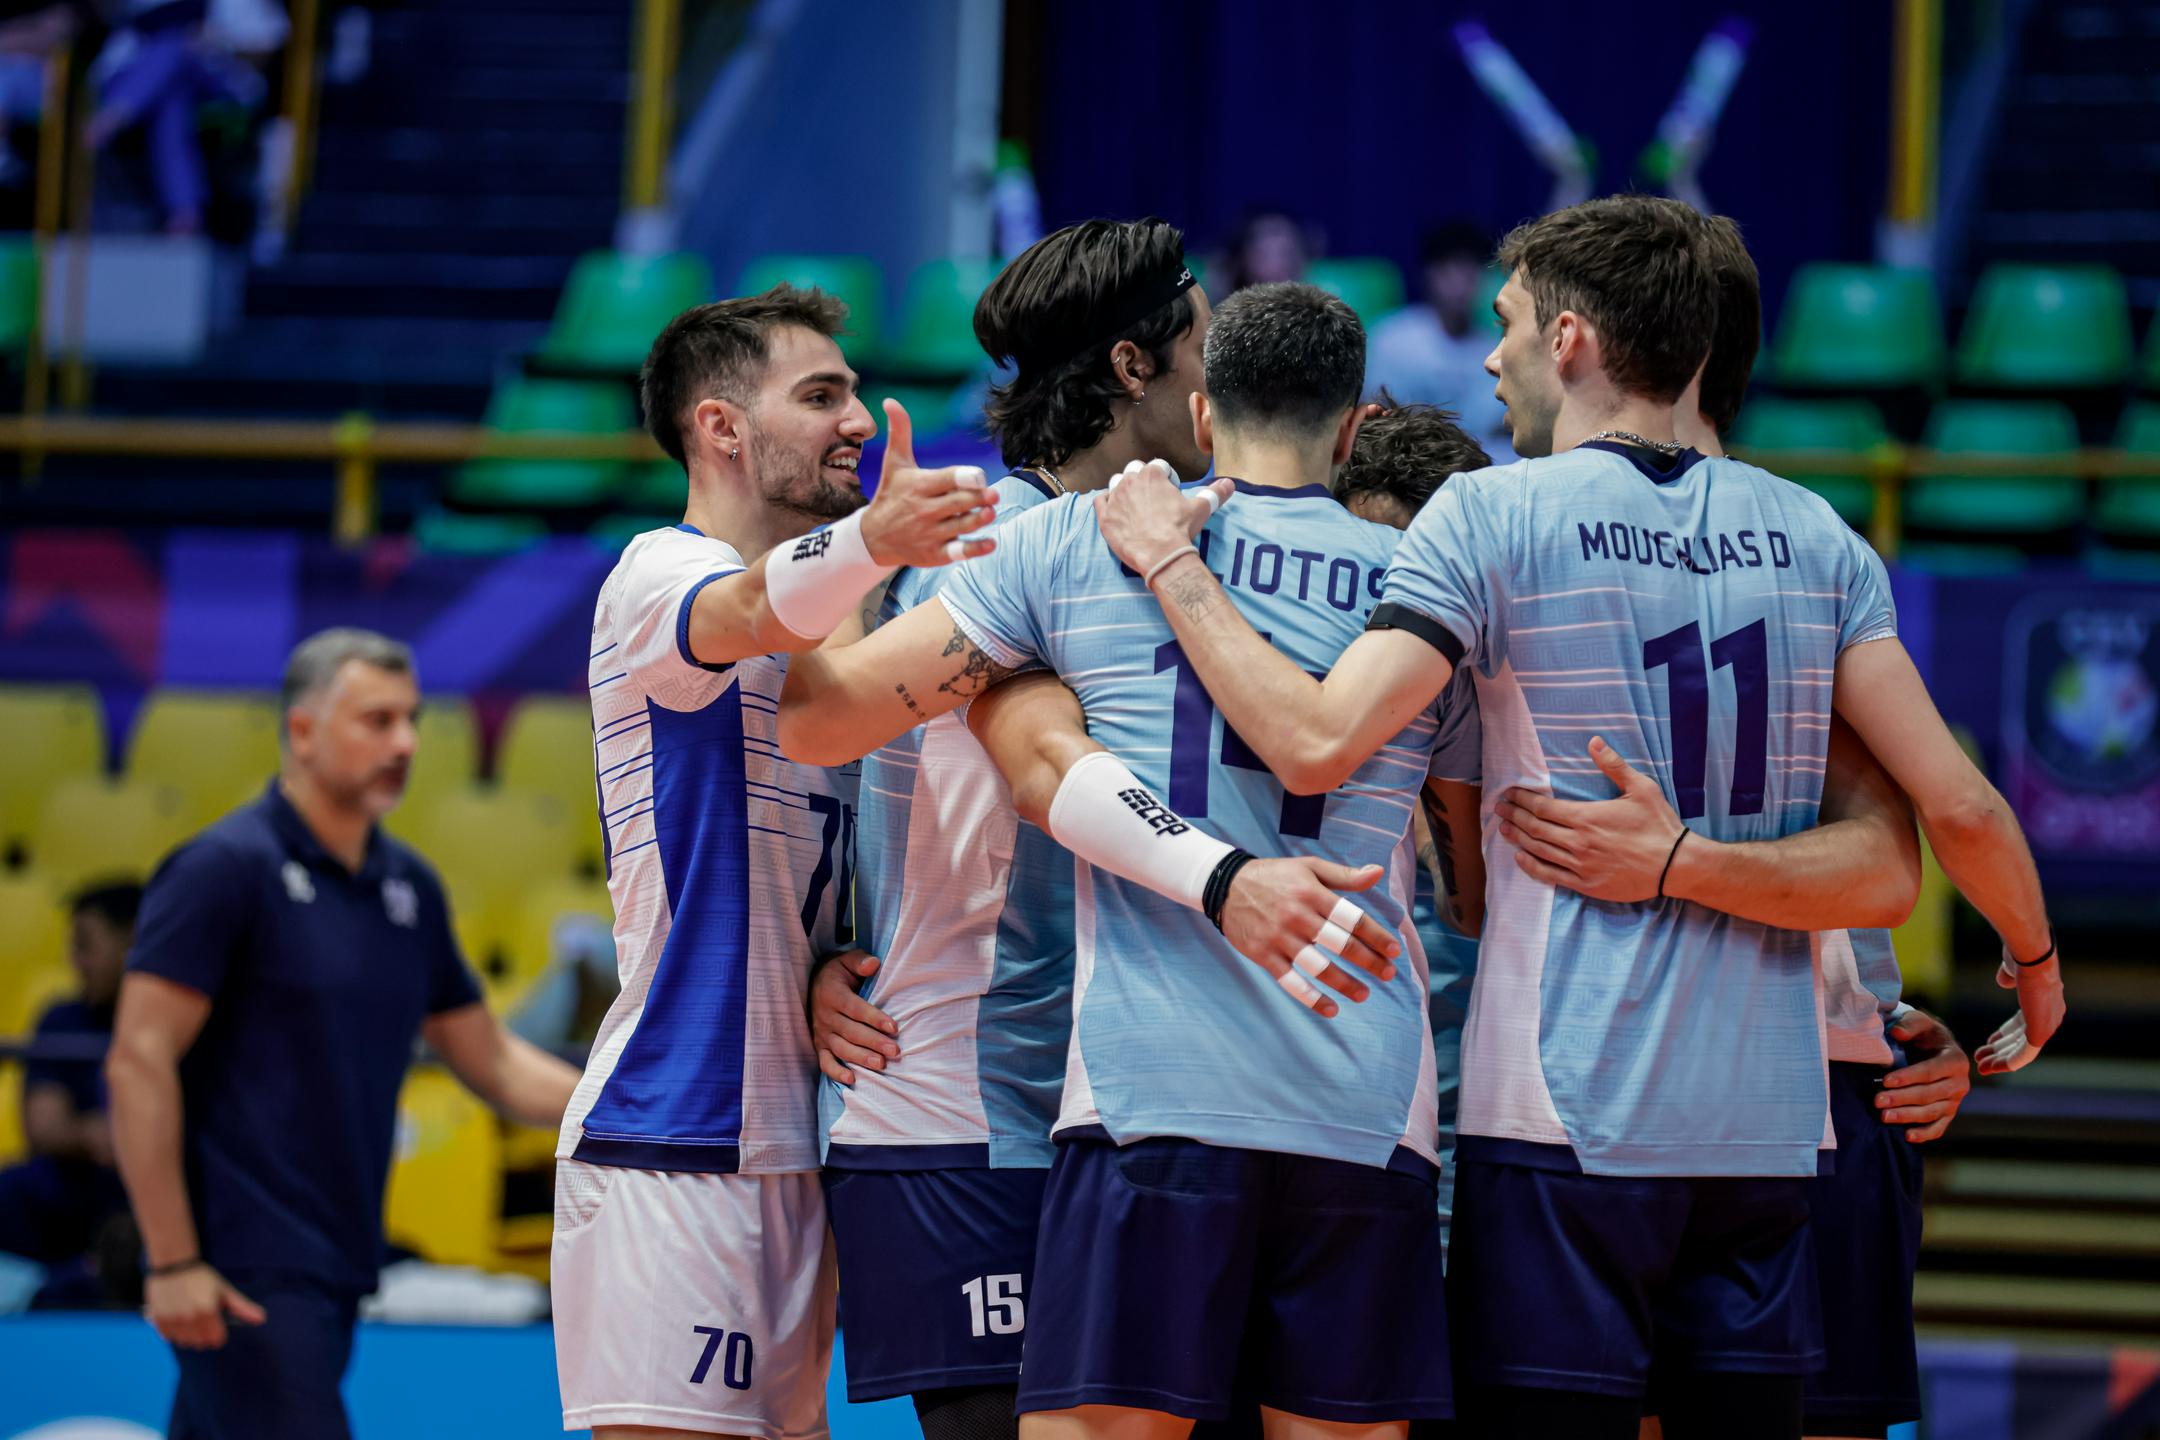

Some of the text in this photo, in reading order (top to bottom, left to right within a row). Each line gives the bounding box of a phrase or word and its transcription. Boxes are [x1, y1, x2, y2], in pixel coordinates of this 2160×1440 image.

[1767, 530, 1792, 569] D
[1153, 632, 1344, 840] 1
[1643, 617, 1769, 819] 11
[962, 1273, 1025, 1337] 15
[690, 1325, 753, 1390] 70
